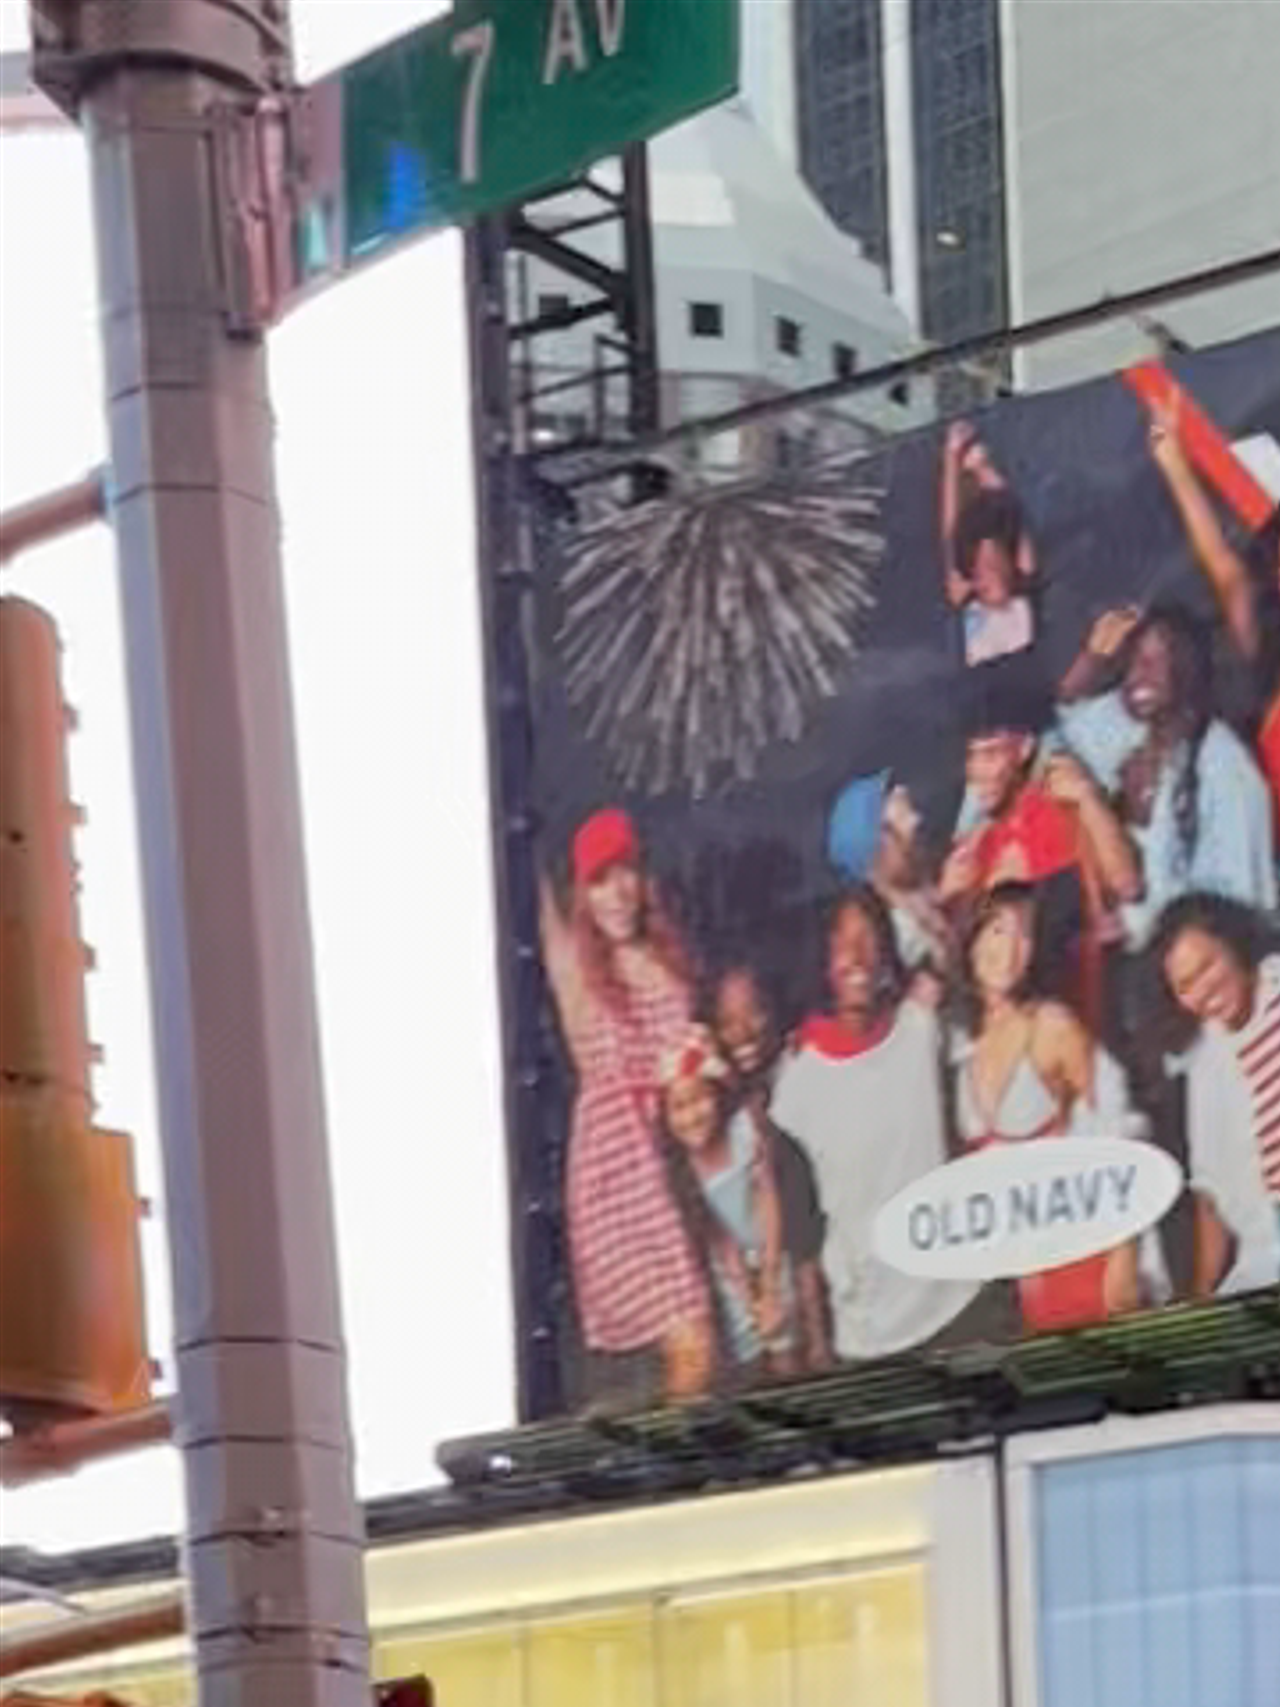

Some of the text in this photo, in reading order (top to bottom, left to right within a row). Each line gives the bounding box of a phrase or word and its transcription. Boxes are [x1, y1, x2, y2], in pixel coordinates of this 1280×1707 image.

[451, 18, 495, 184] 7
[908, 1164, 1138, 1251] OLD NAVY
